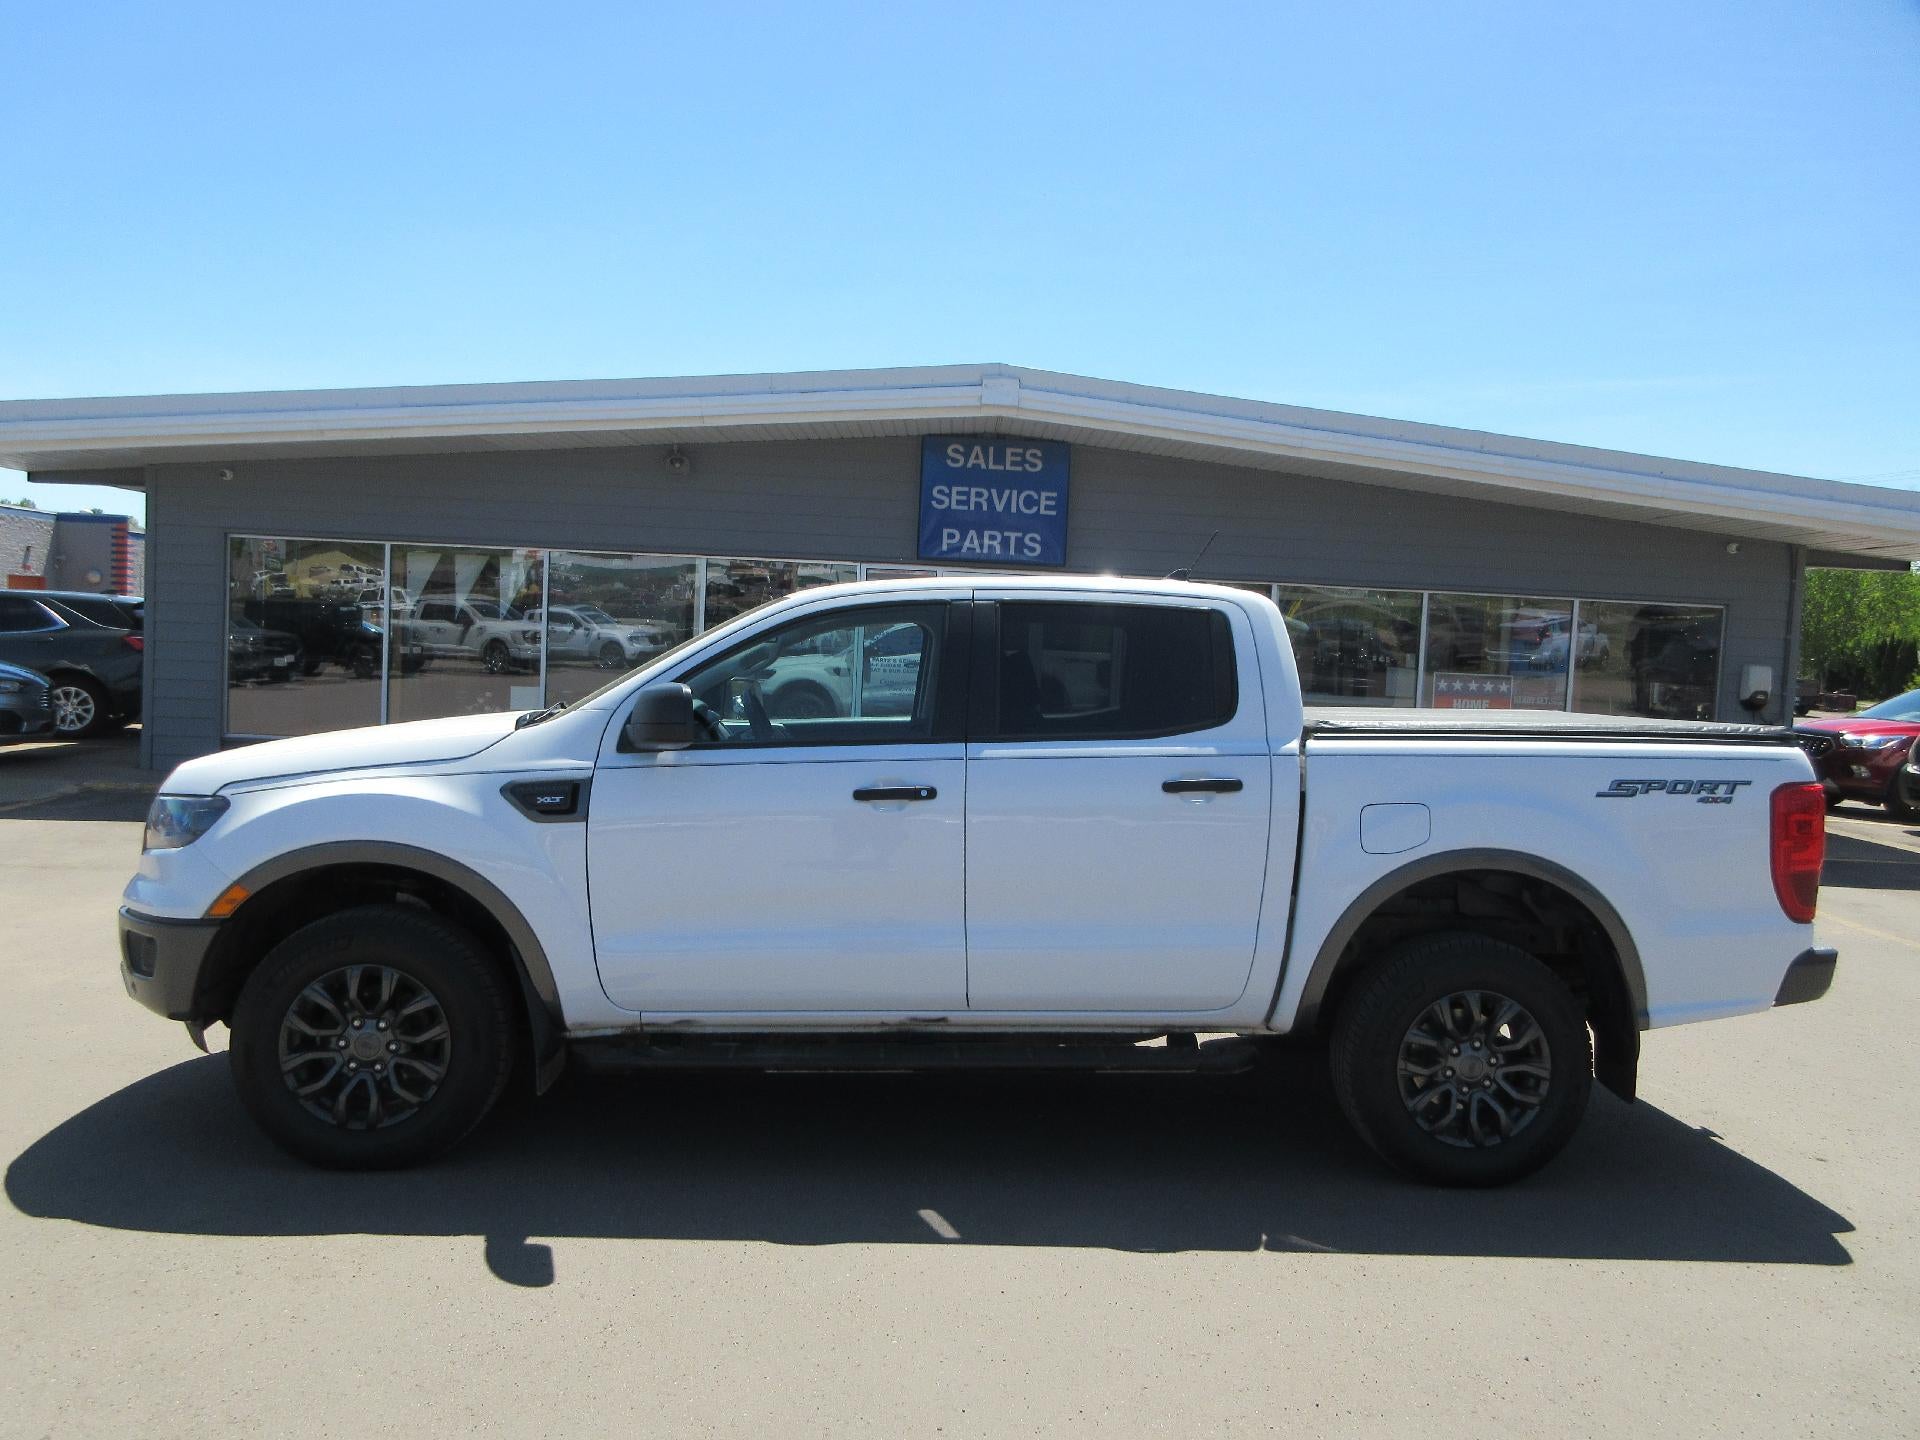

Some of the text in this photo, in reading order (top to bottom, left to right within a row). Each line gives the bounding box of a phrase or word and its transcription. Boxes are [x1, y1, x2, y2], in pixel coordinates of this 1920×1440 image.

[946, 444, 1043, 472] SALES
[931, 485, 1058, 516] SERVICE
[941, 528, 1042, 557] PARTS
[1453, 699, 1490, 709] HOME
[536, 796, 565, 804] XLT
[1595, 779, 1753, 798] SPORT
